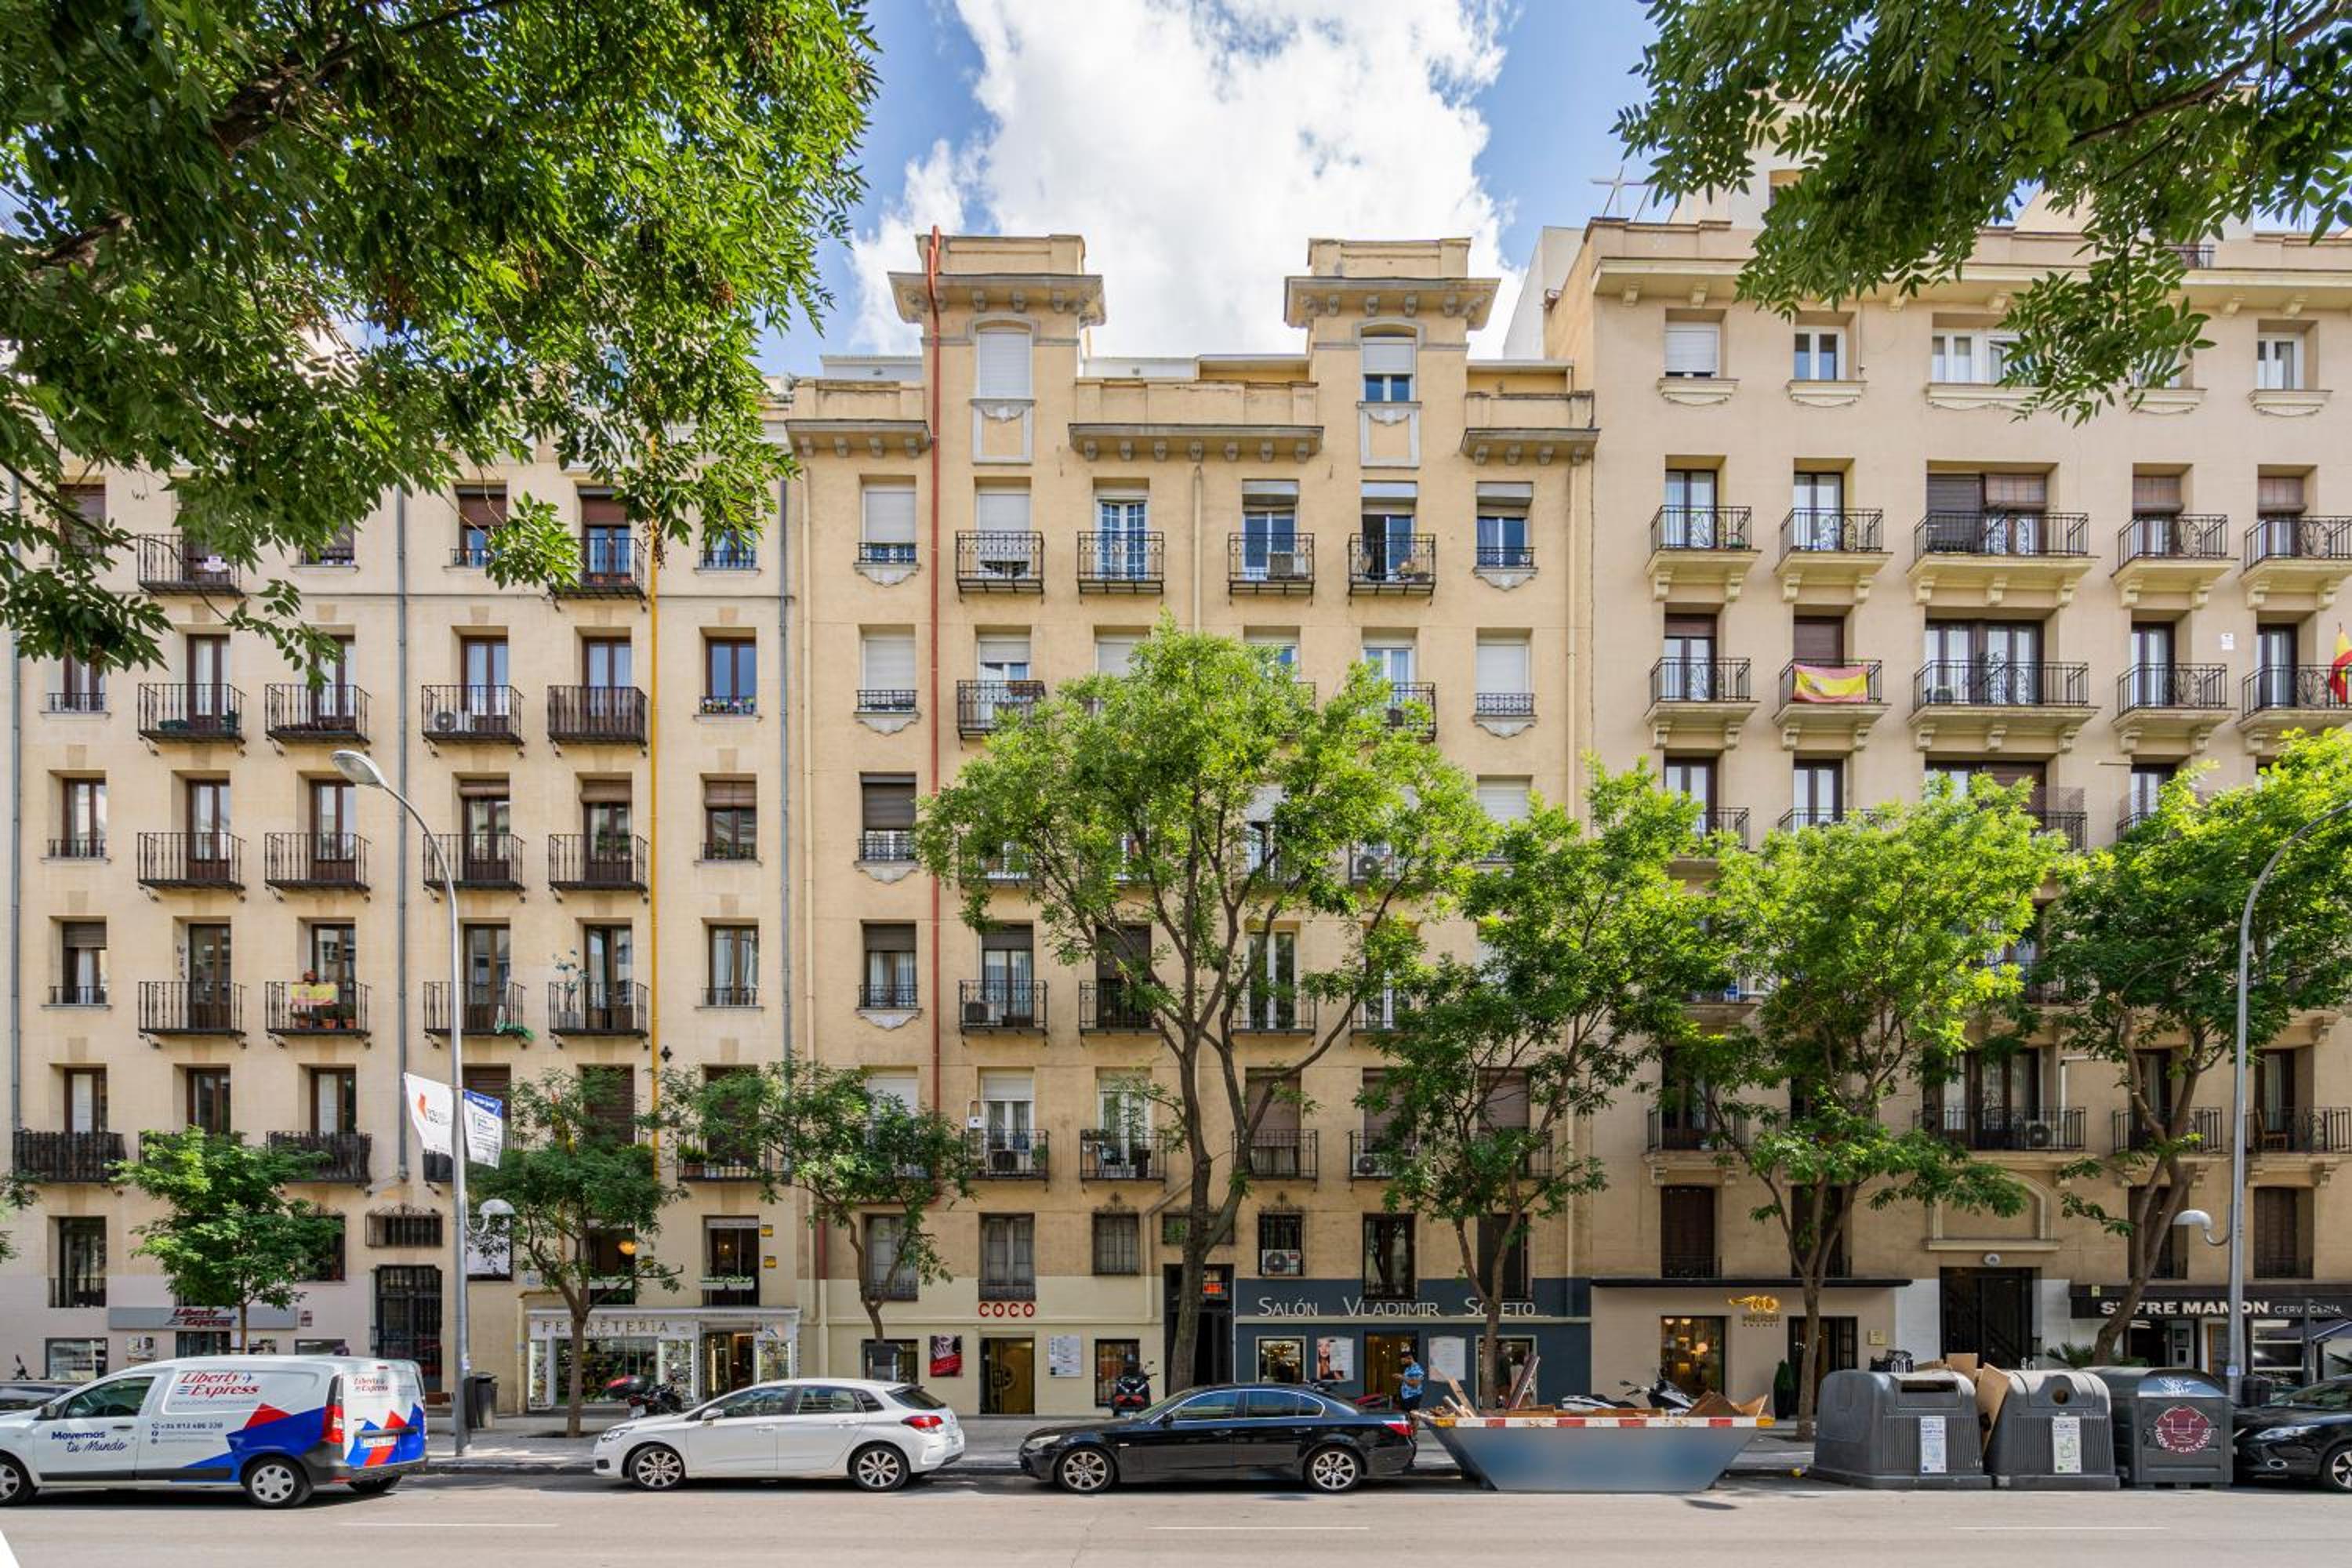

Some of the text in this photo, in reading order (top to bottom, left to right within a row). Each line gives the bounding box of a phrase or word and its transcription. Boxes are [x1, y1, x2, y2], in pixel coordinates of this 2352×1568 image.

[978, 1302, 1036, 1317] COCO
[1342, 1296, 1441, 1317] VLADIMIR
[2100, 1301, 2177, 1315] SFRE
[180, 1370, 238, 1385] Liberty
[190, 1384, 261, 1398] Express
[51, 1431, 106, 1440] Movemos
[83, 1437, 128, 1452] Mundo
